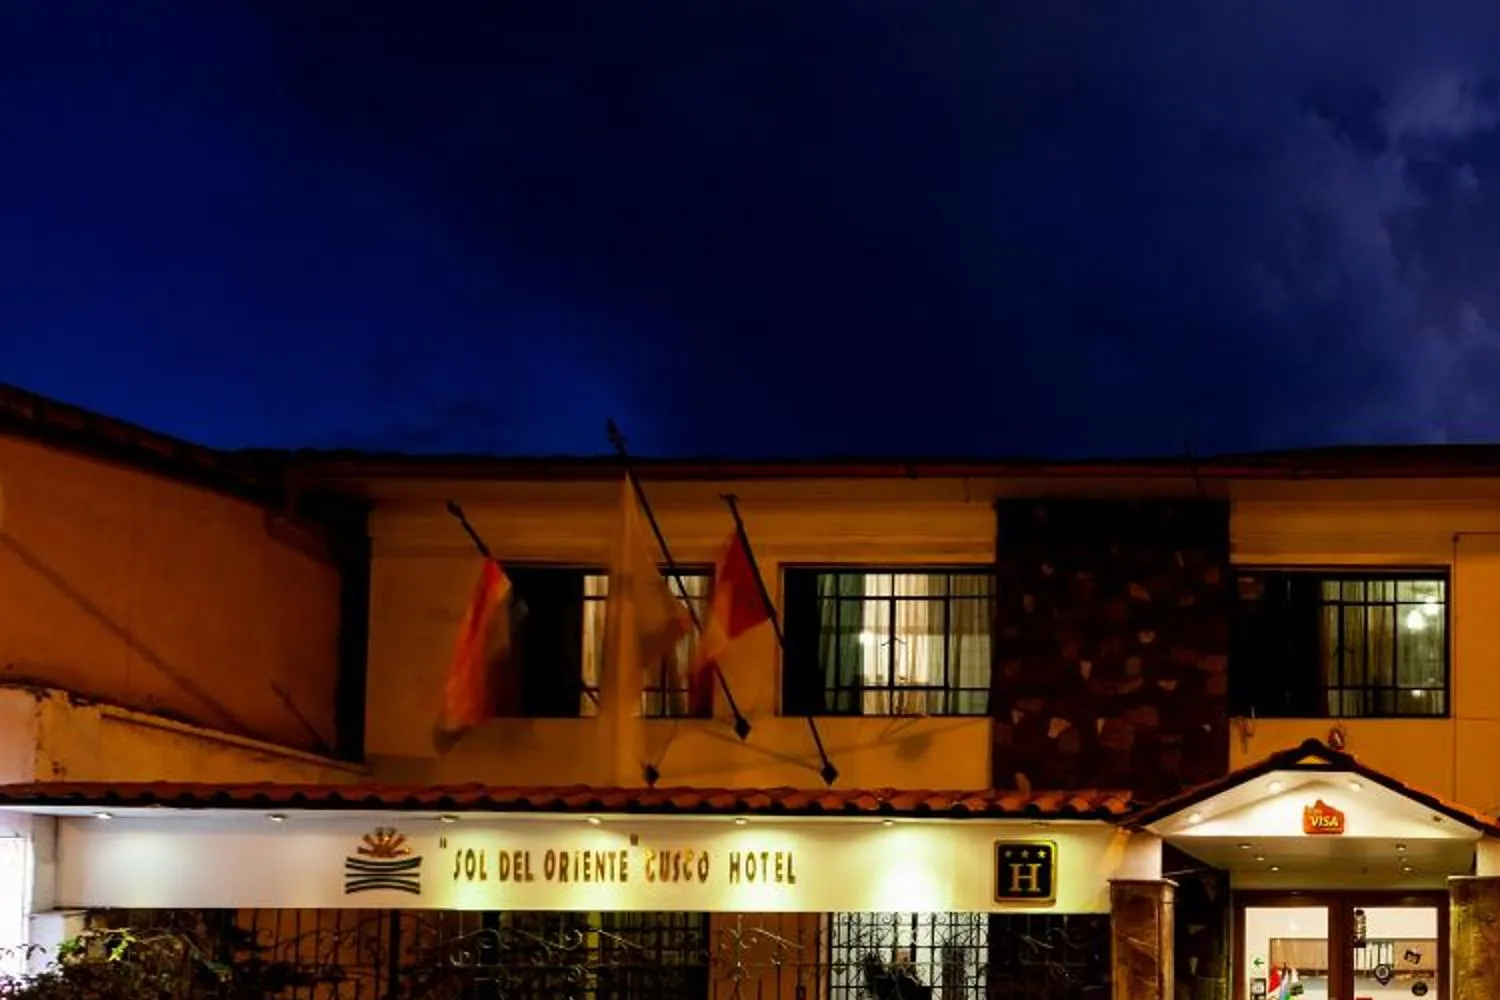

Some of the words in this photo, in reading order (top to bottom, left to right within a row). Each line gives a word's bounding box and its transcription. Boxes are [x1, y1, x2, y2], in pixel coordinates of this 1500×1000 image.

[1311, 815, 1339, 828] VISA
[499, 850, 534, 882] DEL
[644, 848, 709, 884] CUSCO
[728, 850, 796, 884] HOTEL
[1008, 863, 1043, 892] H
